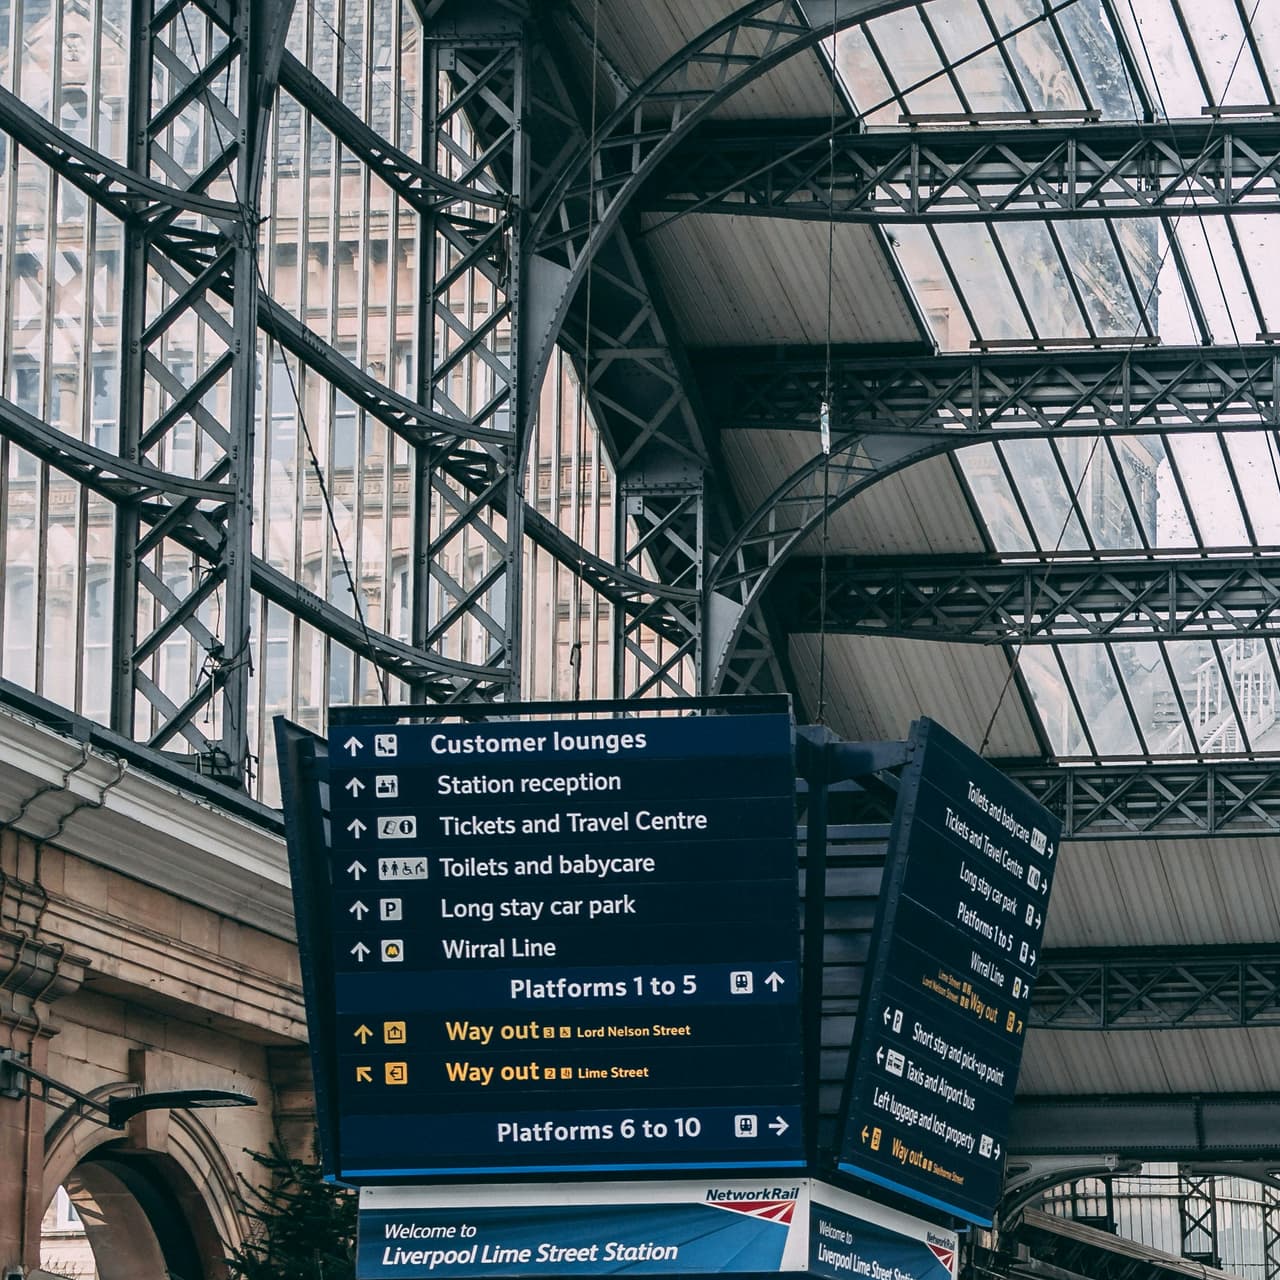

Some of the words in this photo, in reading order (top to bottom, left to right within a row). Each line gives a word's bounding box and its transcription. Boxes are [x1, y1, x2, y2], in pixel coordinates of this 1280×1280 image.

[430, 734, 547, 754] Customer
[553, 731, 647, 754] lounges
[437, 774, 514, 795] Station
[521, 772, 621, 796] reception
[439, 815, 516, 836] Tickets
[521, 813, 560, 834] and
[566, 811, 629, 833] Travel
[635, 810, 708, 831] Centre
[968, 781, 988, 813] Toilets
[989, 800, 1000, 818] and
[1001, 807, 1030, 843] babycare
[945, 808, 969, 842] Tickets
[970, 827, 982, 848] and
[983, 835, 1003, 863] Travel
[1002, 850, 1024, 880] Centre
[438, 857, 509, 877] Toilets
[514, 855, 553, 875] and
[559, 853, 655, 878] babycare
[960, 861, 976, 892] Long
[977, 877, 992, 902] stay
[992, 888, 1003, 905] car
[1002, 892, 1016, 916] park
[441, 898, 494, 922] Long
[500, 898, 544, 921] stay
[550, 900, 584, 916] car
[589, 894, 636, 919] park
[957, 901, 993, 940] Platforms
[994, 926, 998, 944] 1
[999, 931, 1006, 950] to
[1007, 935, 1013, 951] 5
[442, 938, 505, 959] Wirral
[511, 937, 556, 957] Line
[971, 951, 990, 979] Wirral
[990, 961, 1004, 987] Line
[510, 977, 627, 999] Platforms
[633, 976, 643, 996] 1
[649, 977, 676, 996] to
[683, 974, 697, 995] 5
[970, 992, 986, 1019] Way
[986, 1006, 998, 1023] out
[445, 1021, 494, 1045] Way
[500, 1021, 540, 1040] out
[577, 1026, 605, 1038] Lord
[607, 1025, 650, 1037] Nelson
[652, 1024, 691, 1036] Street
[913, 1022, 933, 1049] Short
[934, 1036, 949, 1060] stay
[949, 1044, 963, 1065] and
[961, 1051, 986, 1078] pick-up
[986, 1062, 1004, 1087] point
[445, 1062, 494, 1086] Way
[500, 1062, 540, 1081] out
[578, 1067, 608, 1079] Lime
[610, 1066, 649, 1078] Street
[907, 1060, 924, 1087] Taxis
[924, 1073, 938, 1092] and
[938, 1078, 964, 1105] Airport
[964, 1088, 975, 1111] bus
[497, 1121, 614, 1143] Platforms
[620, 1118, 636, 1139] 6
[642, 1120, 668, 1138] to
[674, 1117, 701, 1138] 10
[874, 1087, 889, 1111] Left
[889, 1091, 918, 1126] luggage
[918, 1109, 932, 1130] and
[932, 1116, 946, 1139] lost
[946, 1127, 975, 1154] property
[892, 1137, 909, 1165] Way
[909, 1150, 923, 1167] out
[706, 1187, 800, 1201] NetworkRail
[385, 1223, 457, 1239] Welcome
[460, 1224, 477, 1238] to
[820, 1220, 845, 1242] Welcome
[846, 1231, 853, 1244] to
[382, 1244, 478, 1270] Liverpool
[481, 1244, 532, 1264] Lime
[535, 1243, 600, 1263] Street
[602, 1242, 679, 1262] Station
[818, 1242, 852, 1270] Liverpool
[853, 1253, 871, 1276] Lime
